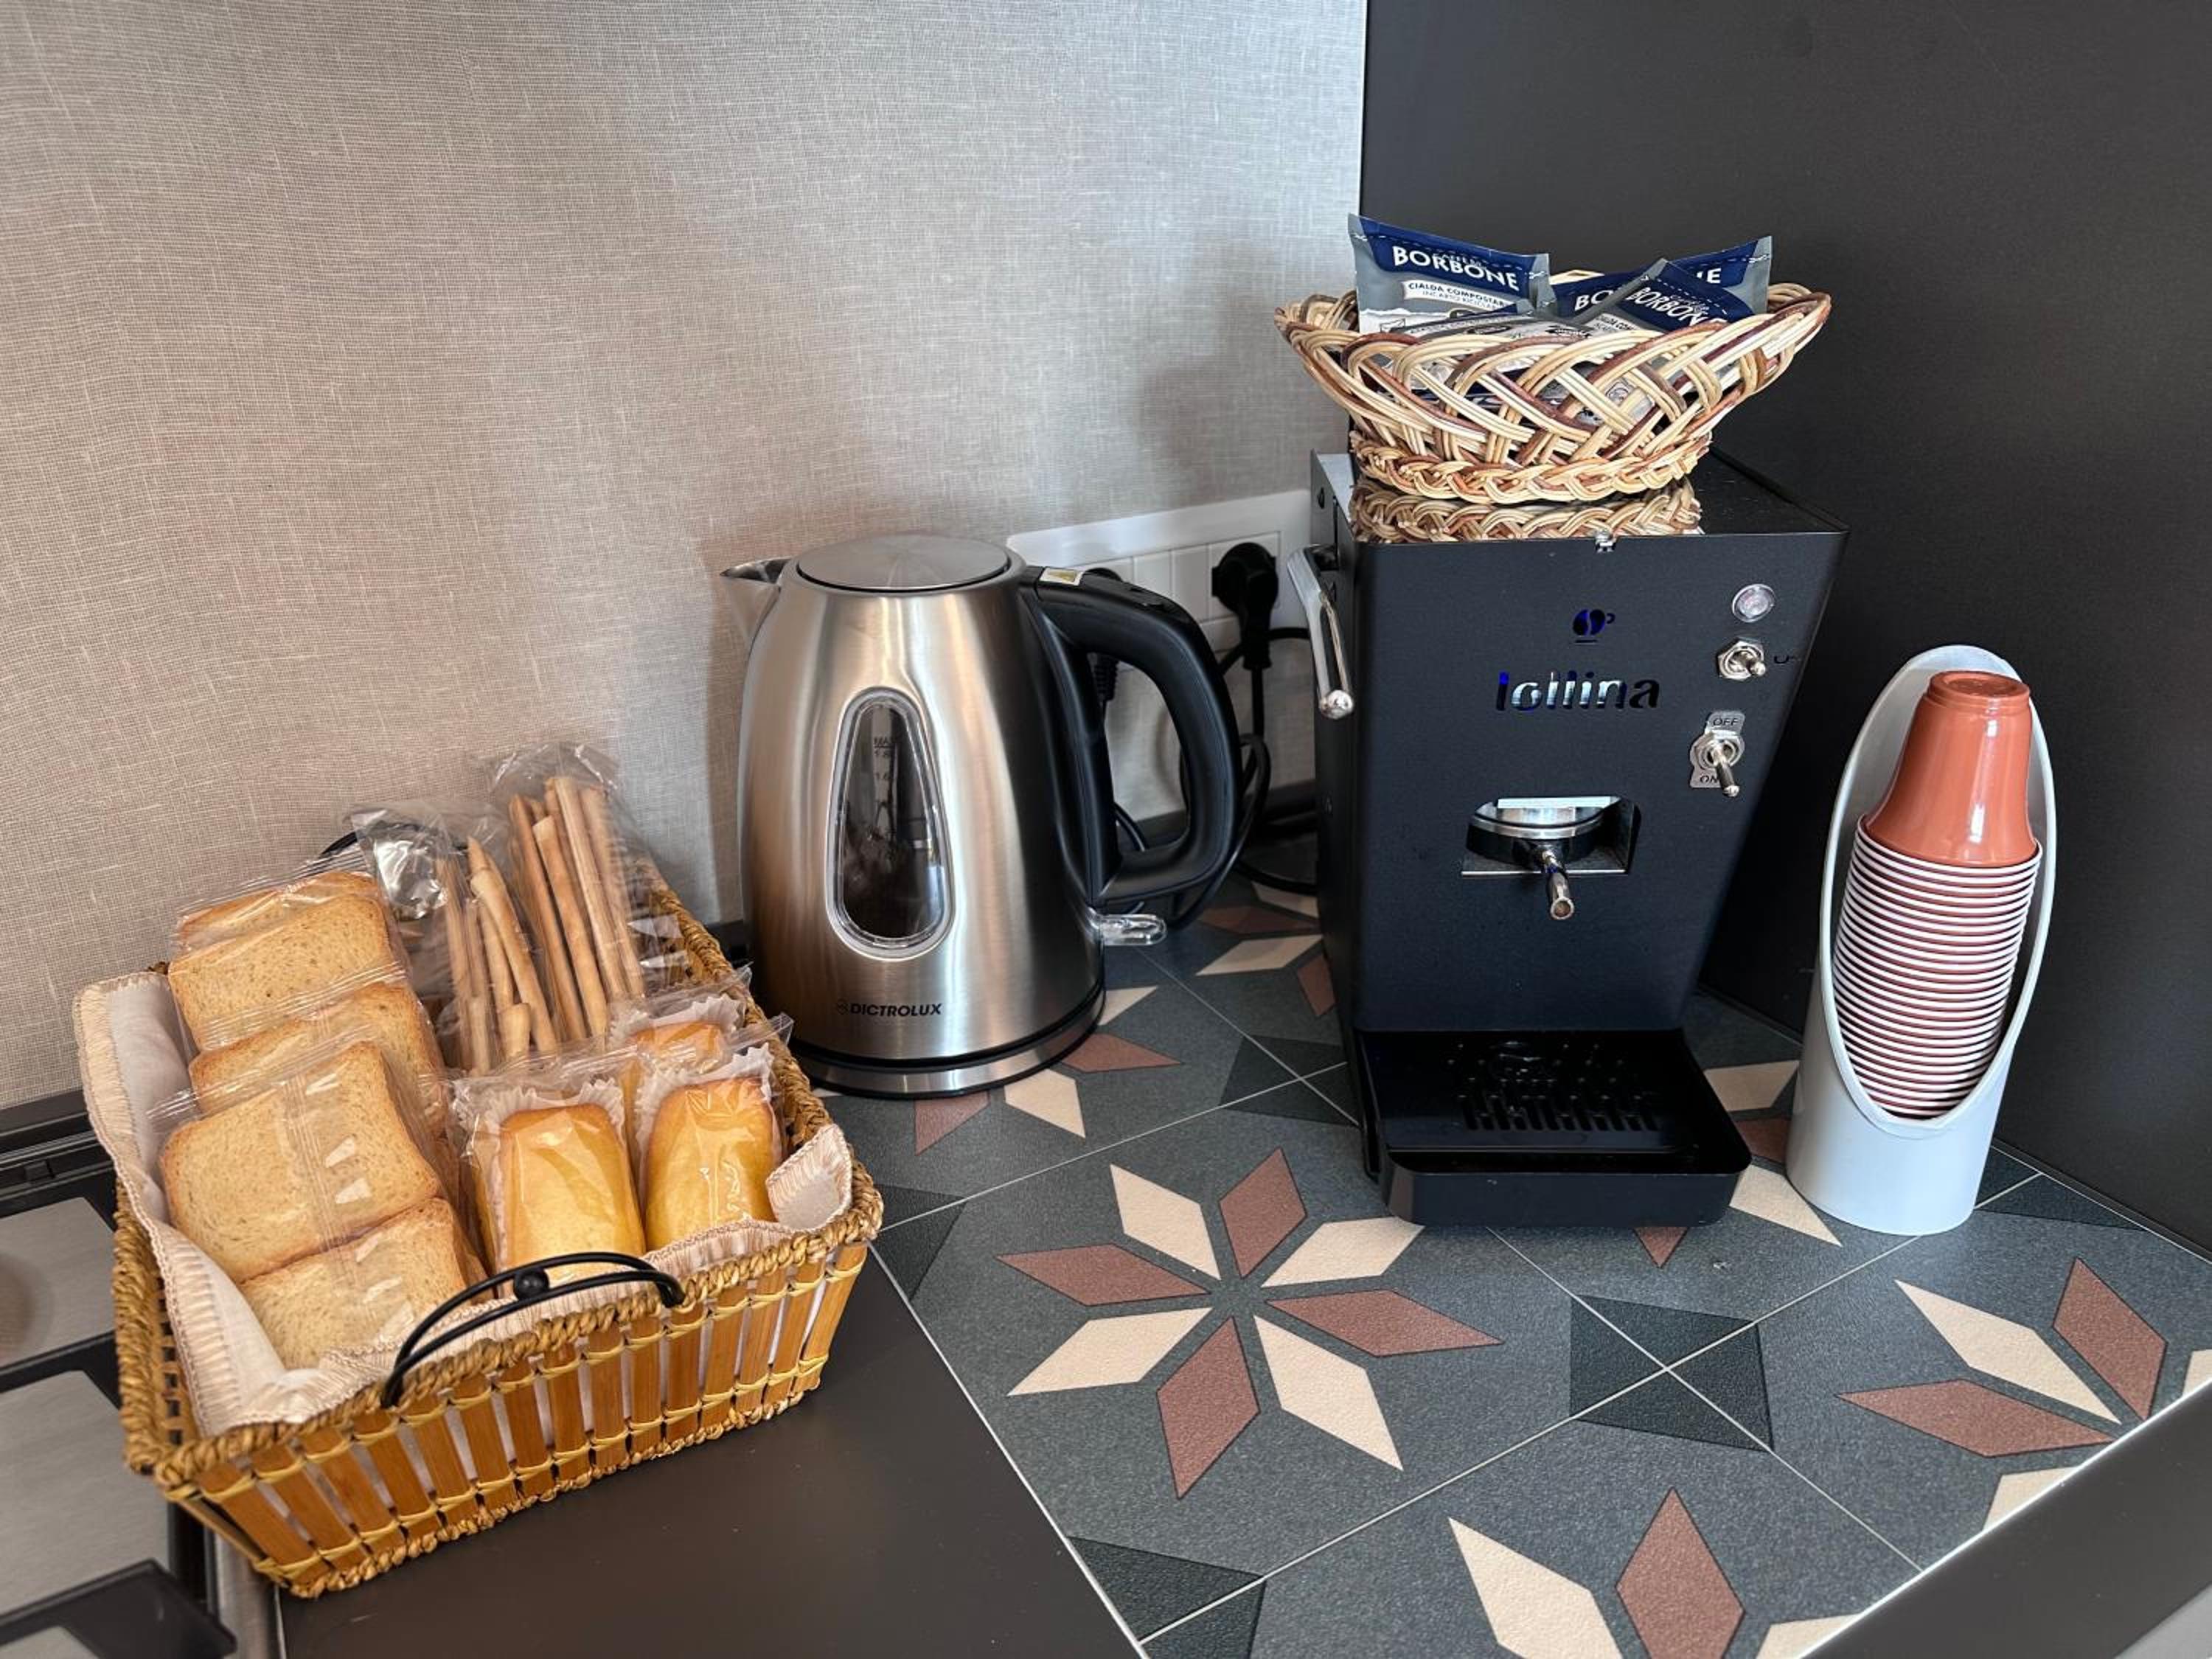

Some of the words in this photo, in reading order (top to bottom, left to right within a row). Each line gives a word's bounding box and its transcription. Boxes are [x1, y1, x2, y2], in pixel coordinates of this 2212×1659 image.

[1392, 246, 1520, 292] BORBONE
[1624, 286, 1727, 327] BORBON
[1713, 717, 1739, 726] OFF
[1700, 775, 1718, 784] ON
[850, 1003, 942, 1017] DICTROLUX
